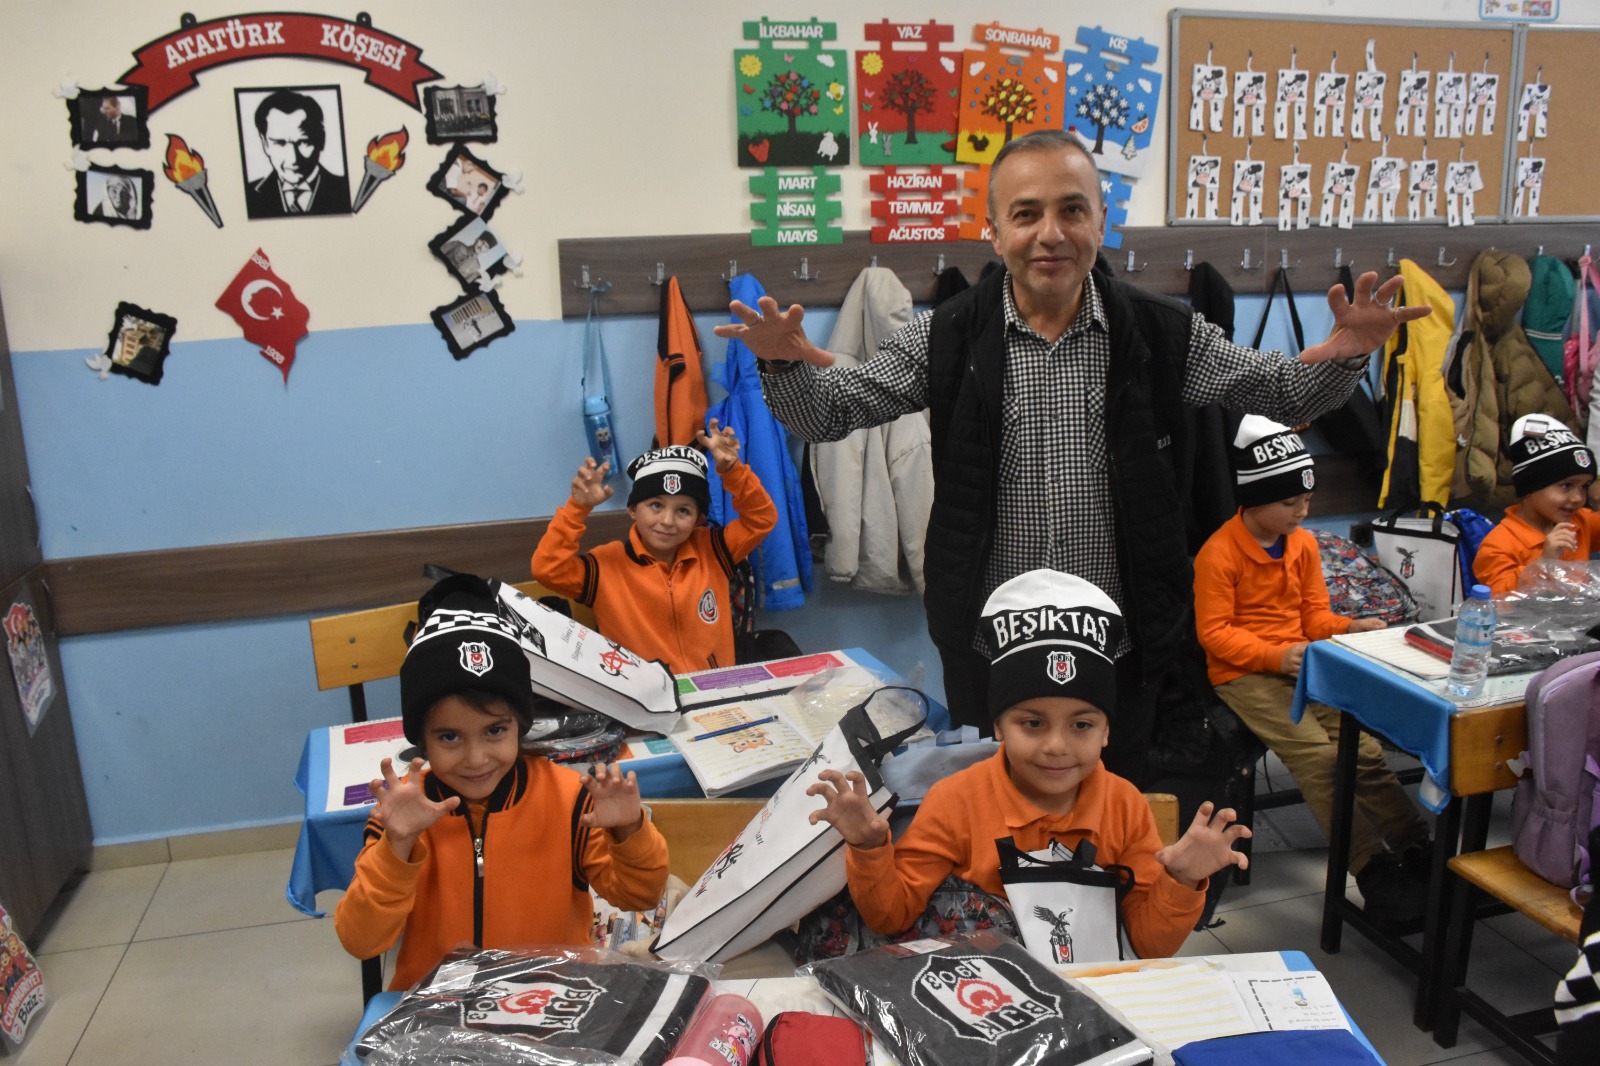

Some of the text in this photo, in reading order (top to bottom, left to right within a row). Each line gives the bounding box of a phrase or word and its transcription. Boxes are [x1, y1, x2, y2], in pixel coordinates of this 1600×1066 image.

[759, 22, 823, 39] İLKBAHAR
[897, 25, 923, 39] YAZ
[985, 28, 1052, 49] SONBAHAR
[164, 19, 407, 72] ATATÜRK KÖŞESİ
[1108, 36, 1129, 53] KIŞ
[778, 175, 818, 190] MART
[887, 173, 943, 189] HAZİRAN
[776, 201, 816, 217] NİSAN
[888, 201, 944, 215] TEMMUZ
[777, 229, 818, 243] MAYIS
[888, 226, 945, 241] AĞUSTOS
[992, 607, 1110, 652] BEŞİKTAŞ
[926, 961, 982, 990] 1903
[18, 994, 39, 1025] Biziz
[540, 988, 597, 1030] BJK
[973, 1000, 1048, 1035] BJK
